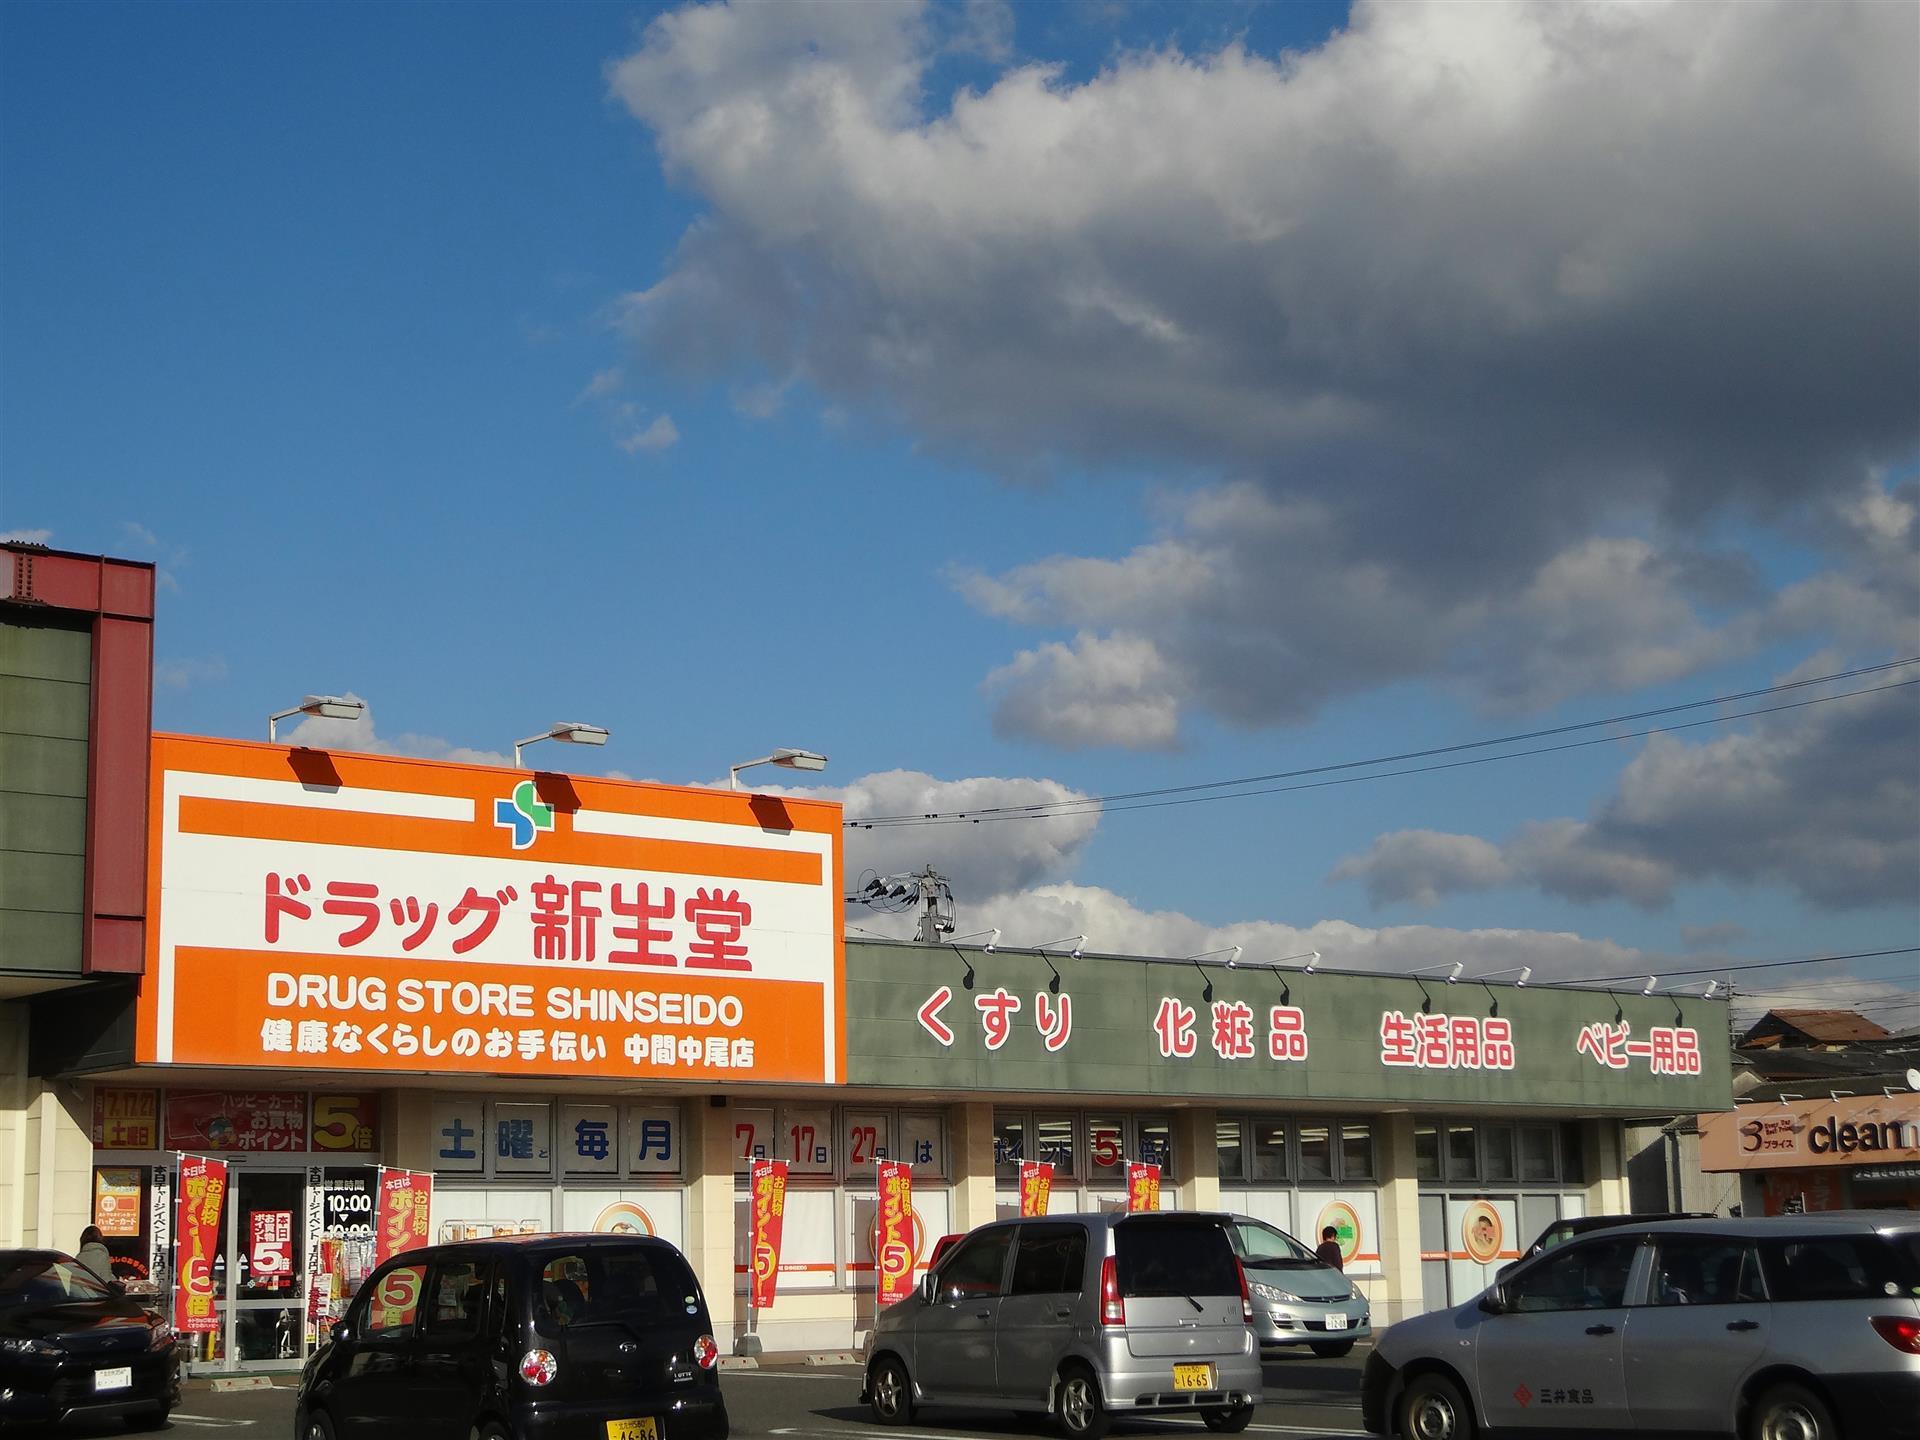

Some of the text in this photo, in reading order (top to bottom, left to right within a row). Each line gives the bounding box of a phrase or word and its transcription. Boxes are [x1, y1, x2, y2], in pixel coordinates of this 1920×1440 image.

[265, 872, 752, 972] ドラッグ新生堂
[266, 972, 744, 1028] DRUG STORE SHINSEIDO
[917, 986, 1701, 1074] くすり 化粧品 生活用品 ベビー用品
[261, 1018, 756, 1070] 健康なくらしのお手伝い 中間中尾店
[251, 1110, 304, 1130] お買物
[313, 1096, 373, 1149] 5倍
[238, 1130, 303, 1150] ポイント
[575, 1119, 671, 1161] 毎月
[790, 1125, 827, 1163] 17日
[915, 1140, 933, 1164] は
[183, 1165, 207, 1177] 本日は
[385, 1177, 411, 1191] 本日は
[755, 1165, 773, 1178] 本日は
[882, 1167, 899, 1178] 本日は
[1023, 1168, 1040, 1178] 本日は
[1132, 1168, 1148, 1179] 本日は
[324, 1180, 365, 1191] 営業時間
[771, 1175, 785, 1217] お買物
[899, 1177, 912, 1217] お買物
[201, 1178, 224, 1227] お買物
[327, 1194, 371, 1212] 10:00
[413, 1189, 429, 1236] お買物
[255, 1213, 265, 1242] ポイント
[265, 1213, 275, 1242] お買物
[278, 1215, 288, 1240] 本日
[253, 1242, 291, 1272] 5倍
[1182, 1374, 1207, 1387] 16-65
[1540, 1388, 1594, 1404] 三井食品
